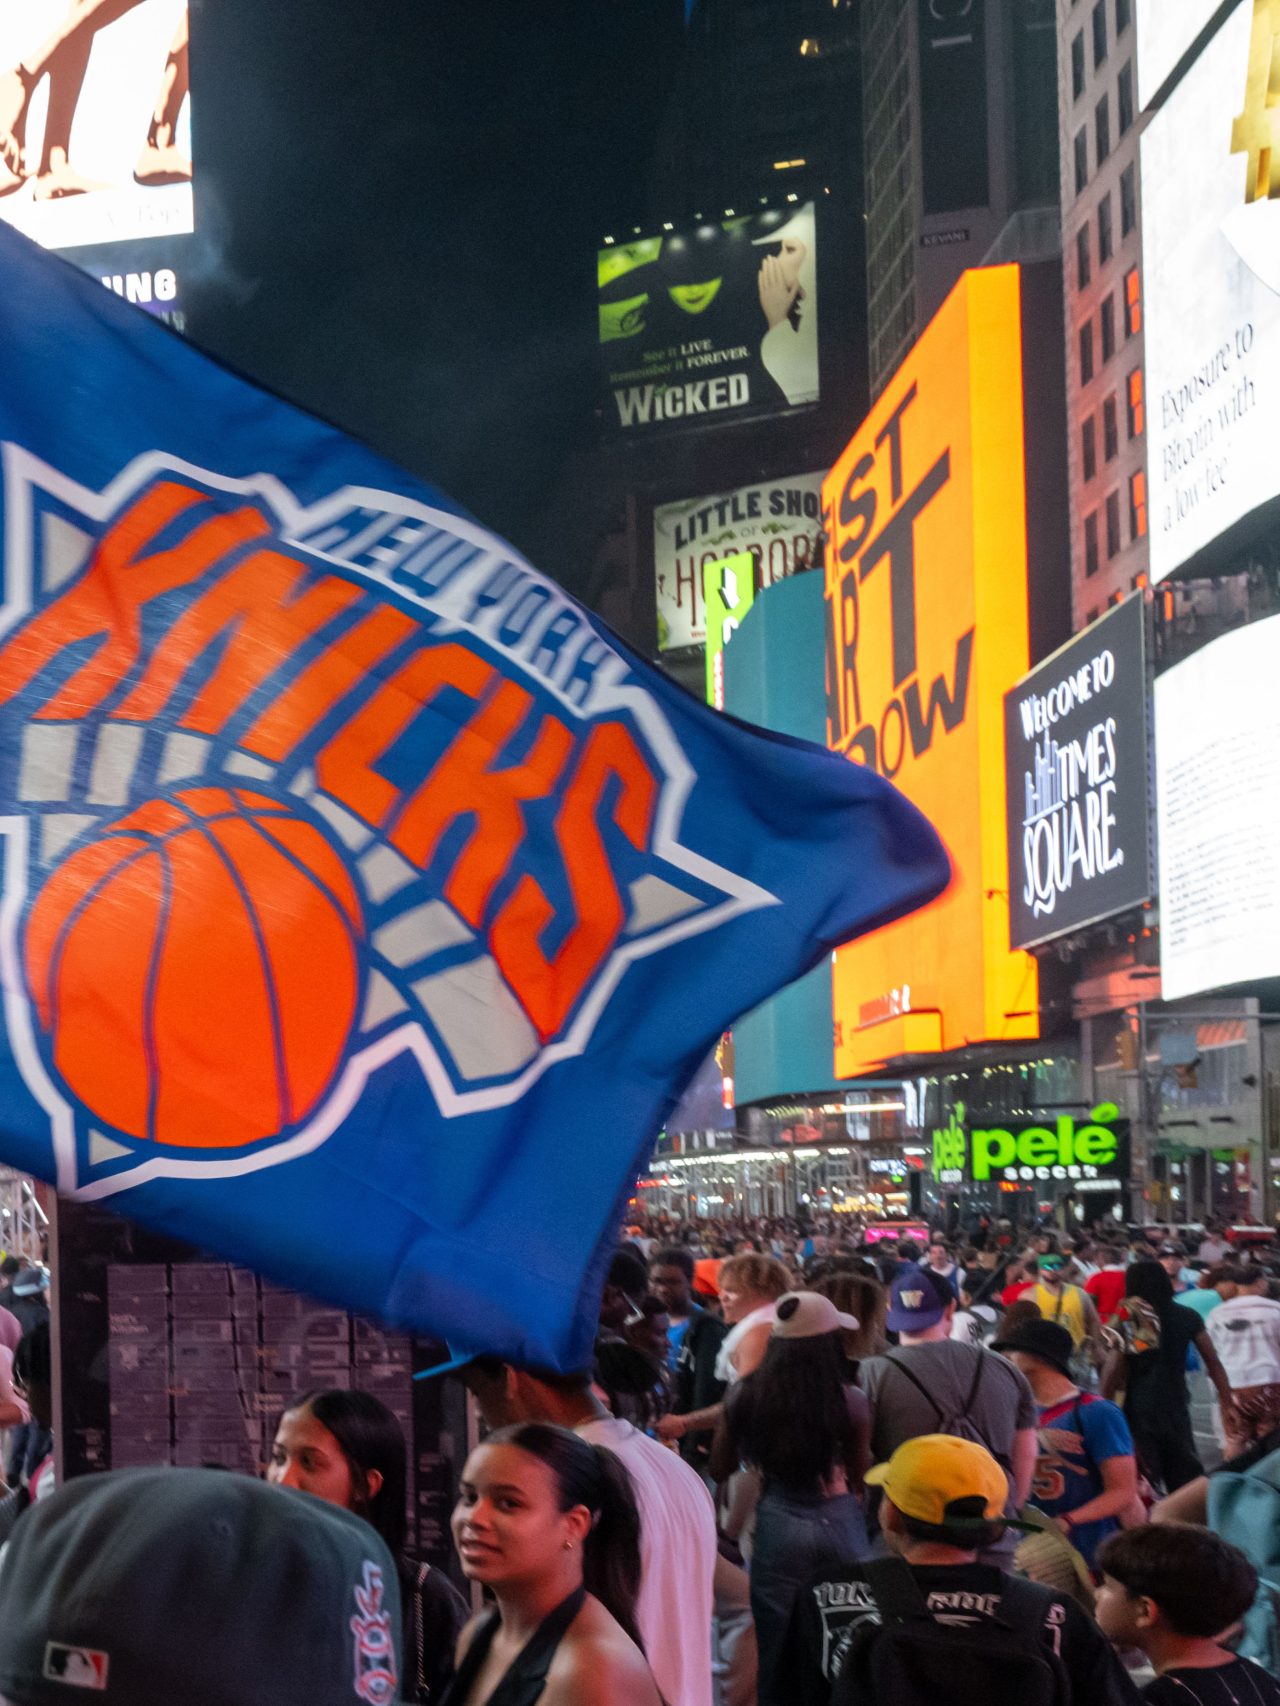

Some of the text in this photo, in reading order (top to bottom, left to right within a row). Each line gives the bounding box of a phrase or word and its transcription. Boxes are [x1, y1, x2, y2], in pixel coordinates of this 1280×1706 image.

[1161, 322, 1255, 430] Exposure to
[1162, 374, 1257, 483] Bitcoin with
[300, 503, 488, 601] NEW
[674, 489, 821, 551] LITTLE SHO
[1019, 649, 1115, 742] WELCOME TO
[1054, 716, 1117, 803] TIMES
[1023, 779, 1124, 920] SQUARE
[971, 1101, 1120, 1182] pelé
[1003, 1164, 1098, 1181] SOCCER
